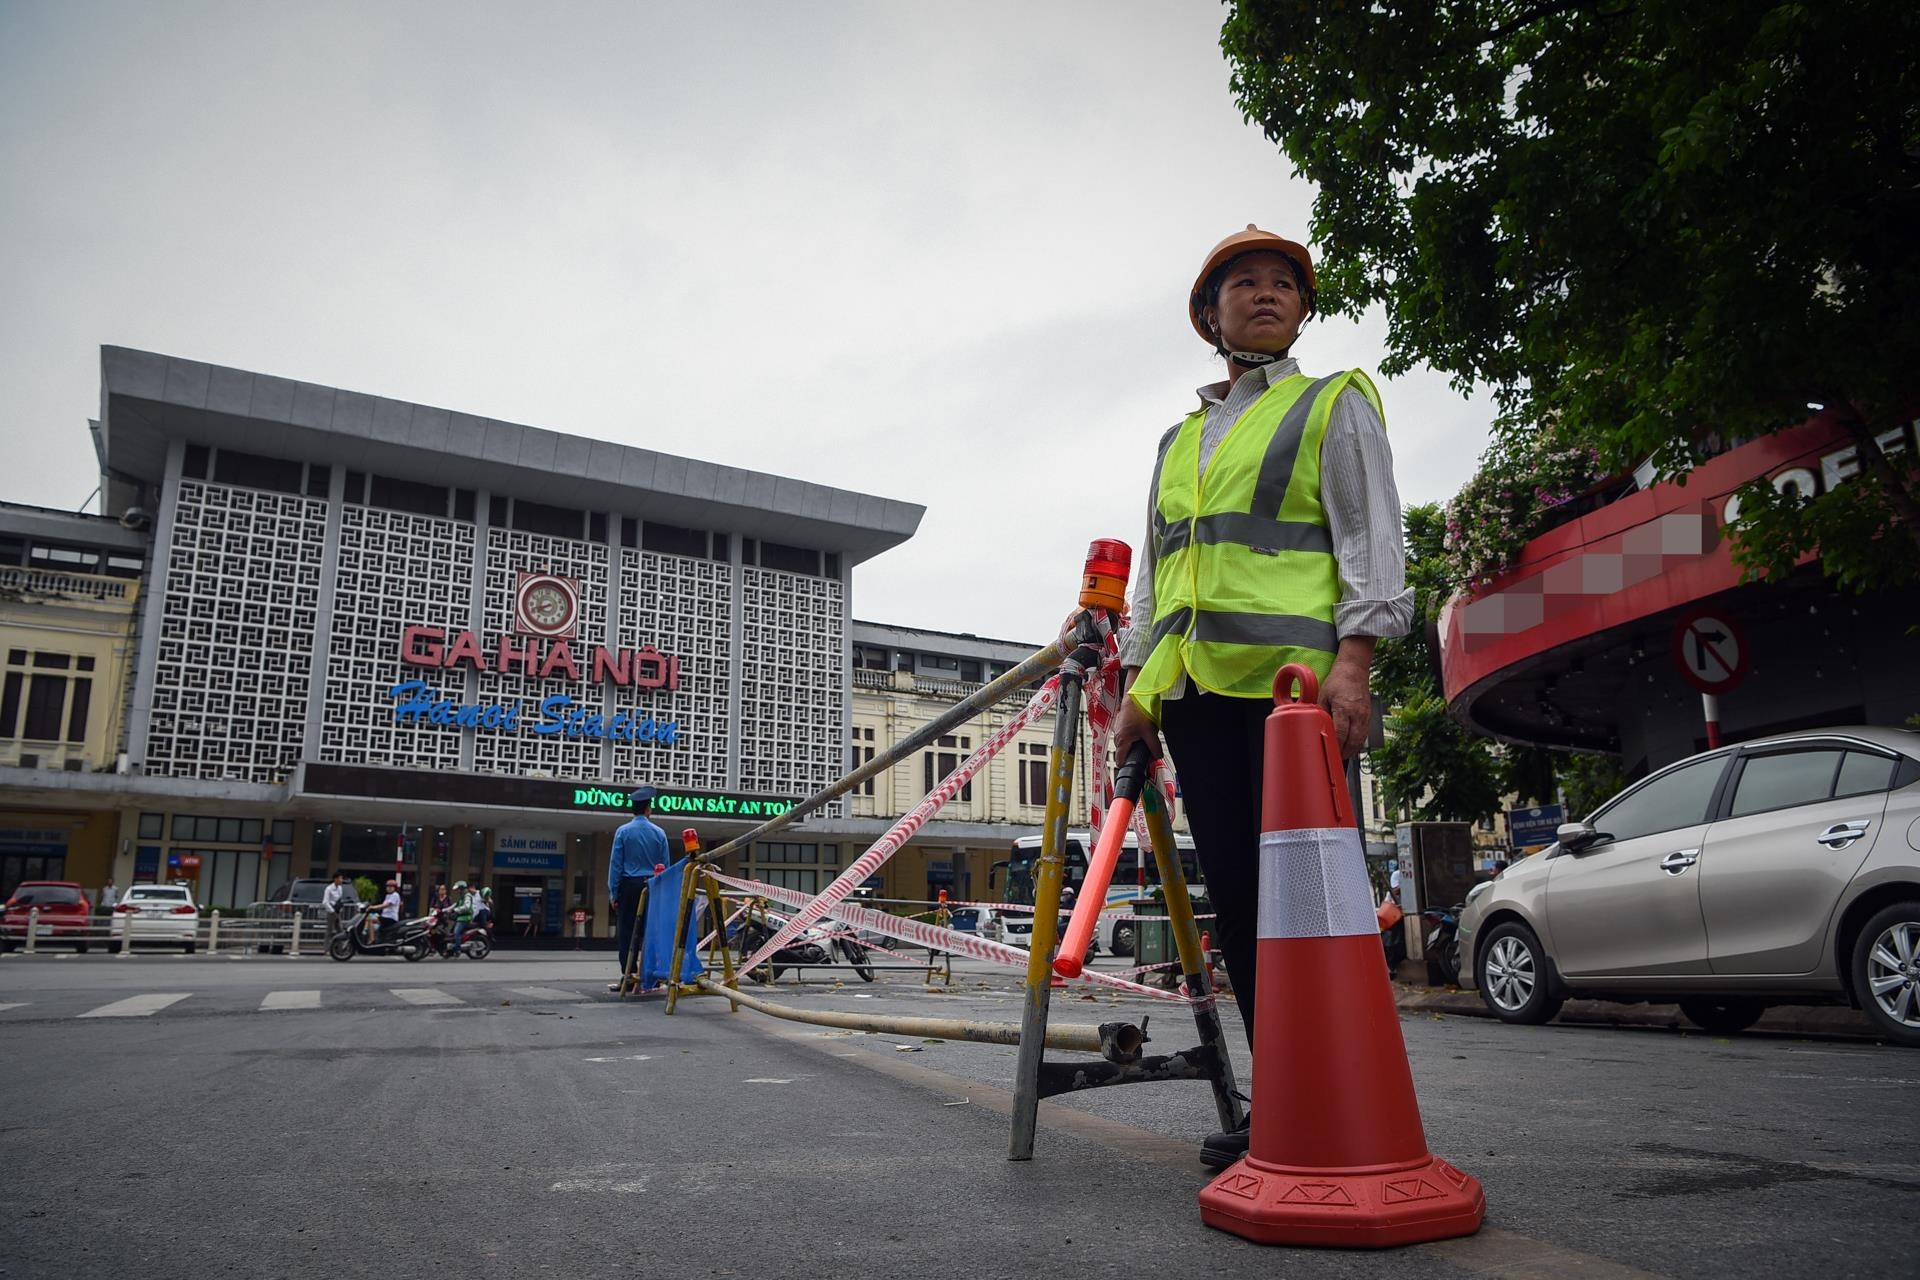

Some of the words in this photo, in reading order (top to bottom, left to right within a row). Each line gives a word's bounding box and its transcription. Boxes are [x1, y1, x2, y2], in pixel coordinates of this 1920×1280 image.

[402, 625, 487, 670] GA
[496, 636, 580, 681] HÀ
[592, 644, 680, 692] NỘI
[389, 680, 524, 731] Hanoi
[533, 694, 681, 745] Station
[573, 787, 625, 807] DỪNG
[658, 795, 705, 813] QUAN
[706, 795, 737, 814] SÁT
[738, 800, 762, 816] AN
[764, 800, 798, 816] TOÀ
[507, 856, 529, 865] MAIN
[531, 857, 549, 865] HALL
